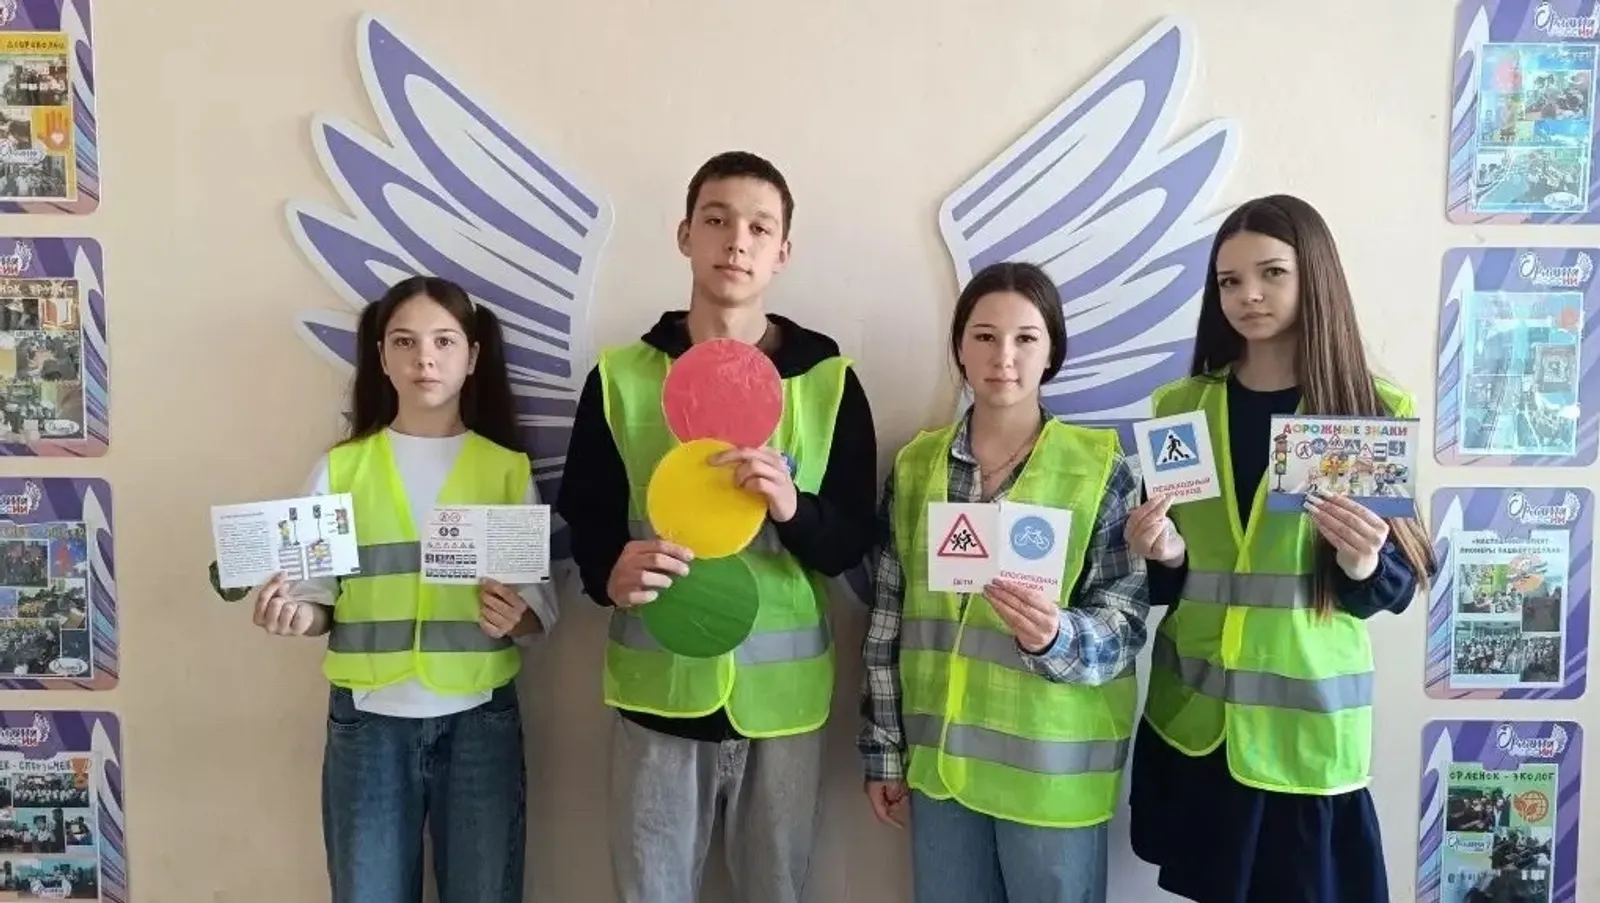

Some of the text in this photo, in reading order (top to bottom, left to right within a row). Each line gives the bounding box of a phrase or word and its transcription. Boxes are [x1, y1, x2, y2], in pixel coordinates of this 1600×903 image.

[1283, 423, 1408, 436] ДОРОЖНЫЕ ЗНАКИ
[953, 578, 974, 586] ДЕТИ
[1000, 570, 1058, 585] ЕЛОСИПЕДНАЯ
[1513, 772, 1555, 782] ЭКОЛОГ
